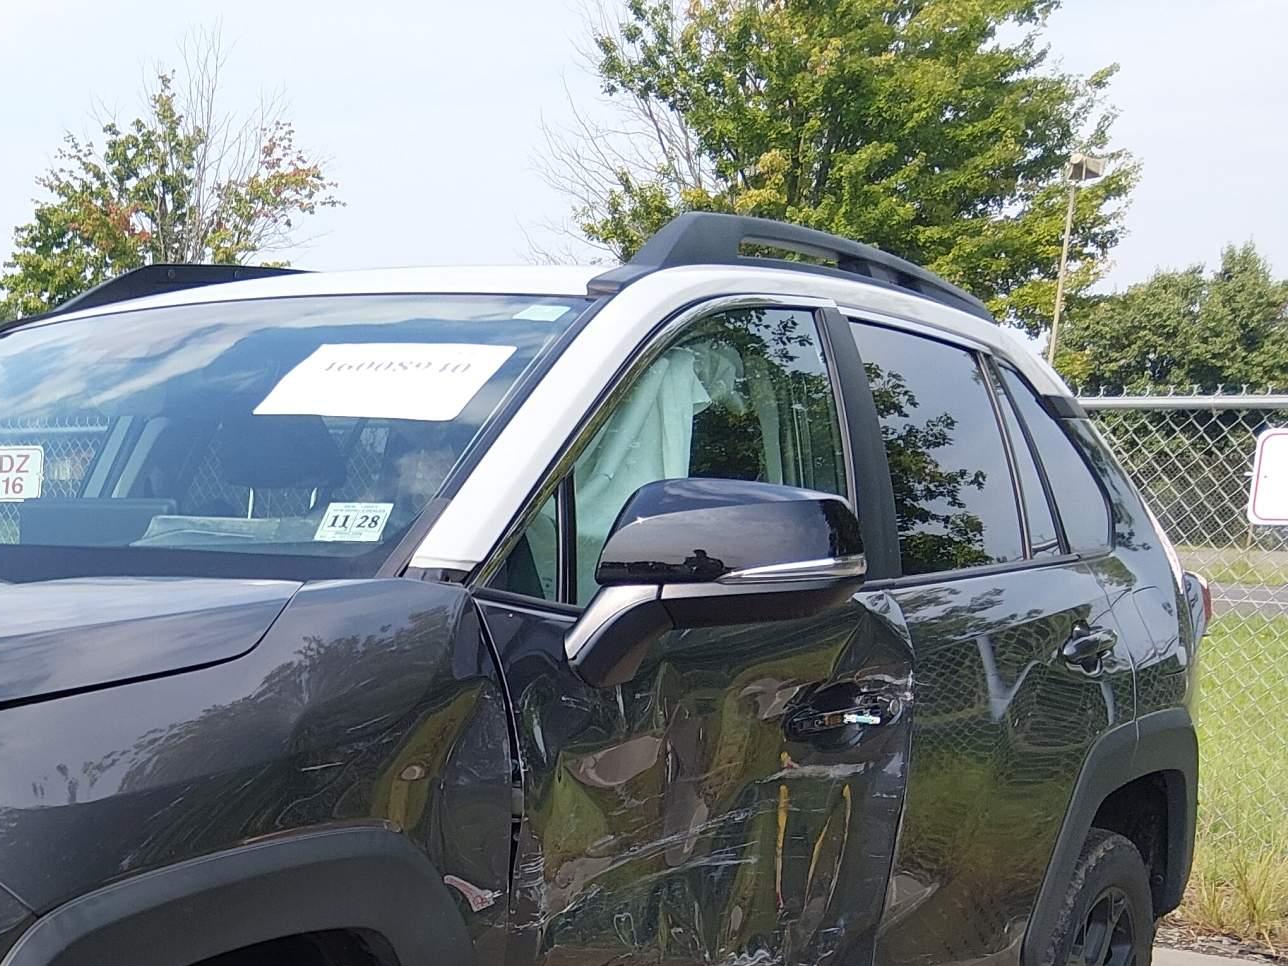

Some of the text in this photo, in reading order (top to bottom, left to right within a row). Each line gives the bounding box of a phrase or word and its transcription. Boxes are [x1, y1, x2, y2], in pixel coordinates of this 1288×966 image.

[1, 476, 24, 495] 16
[327, 514, 381, 529] 11 28
